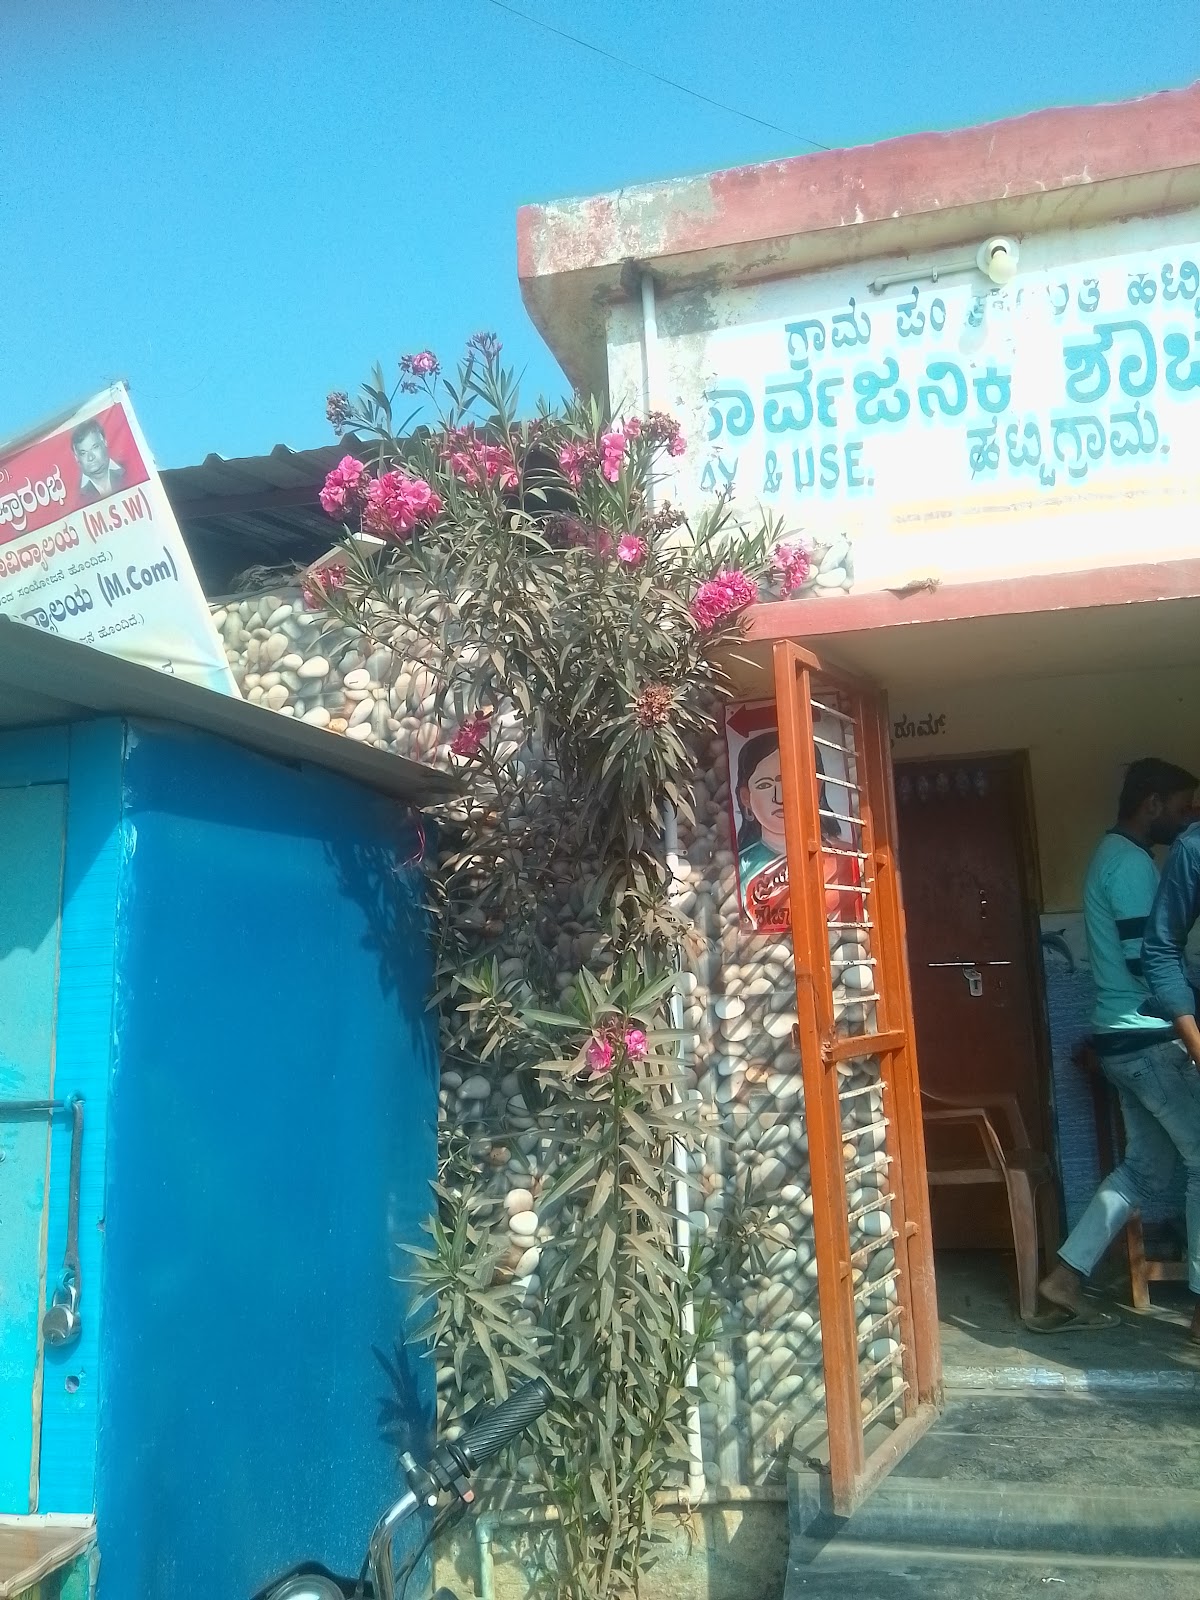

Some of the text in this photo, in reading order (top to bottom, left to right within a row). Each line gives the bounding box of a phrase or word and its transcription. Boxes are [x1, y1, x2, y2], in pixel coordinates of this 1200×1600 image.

[784, 296, 872, 371] ಗ್ರಾಮ
[762, 449, 783, 494] &
[792, 441, 875, 493] USE.
[82, 486, 153, 545] (M.S.W)
[96, 545, 179, 608] (M.Com)
